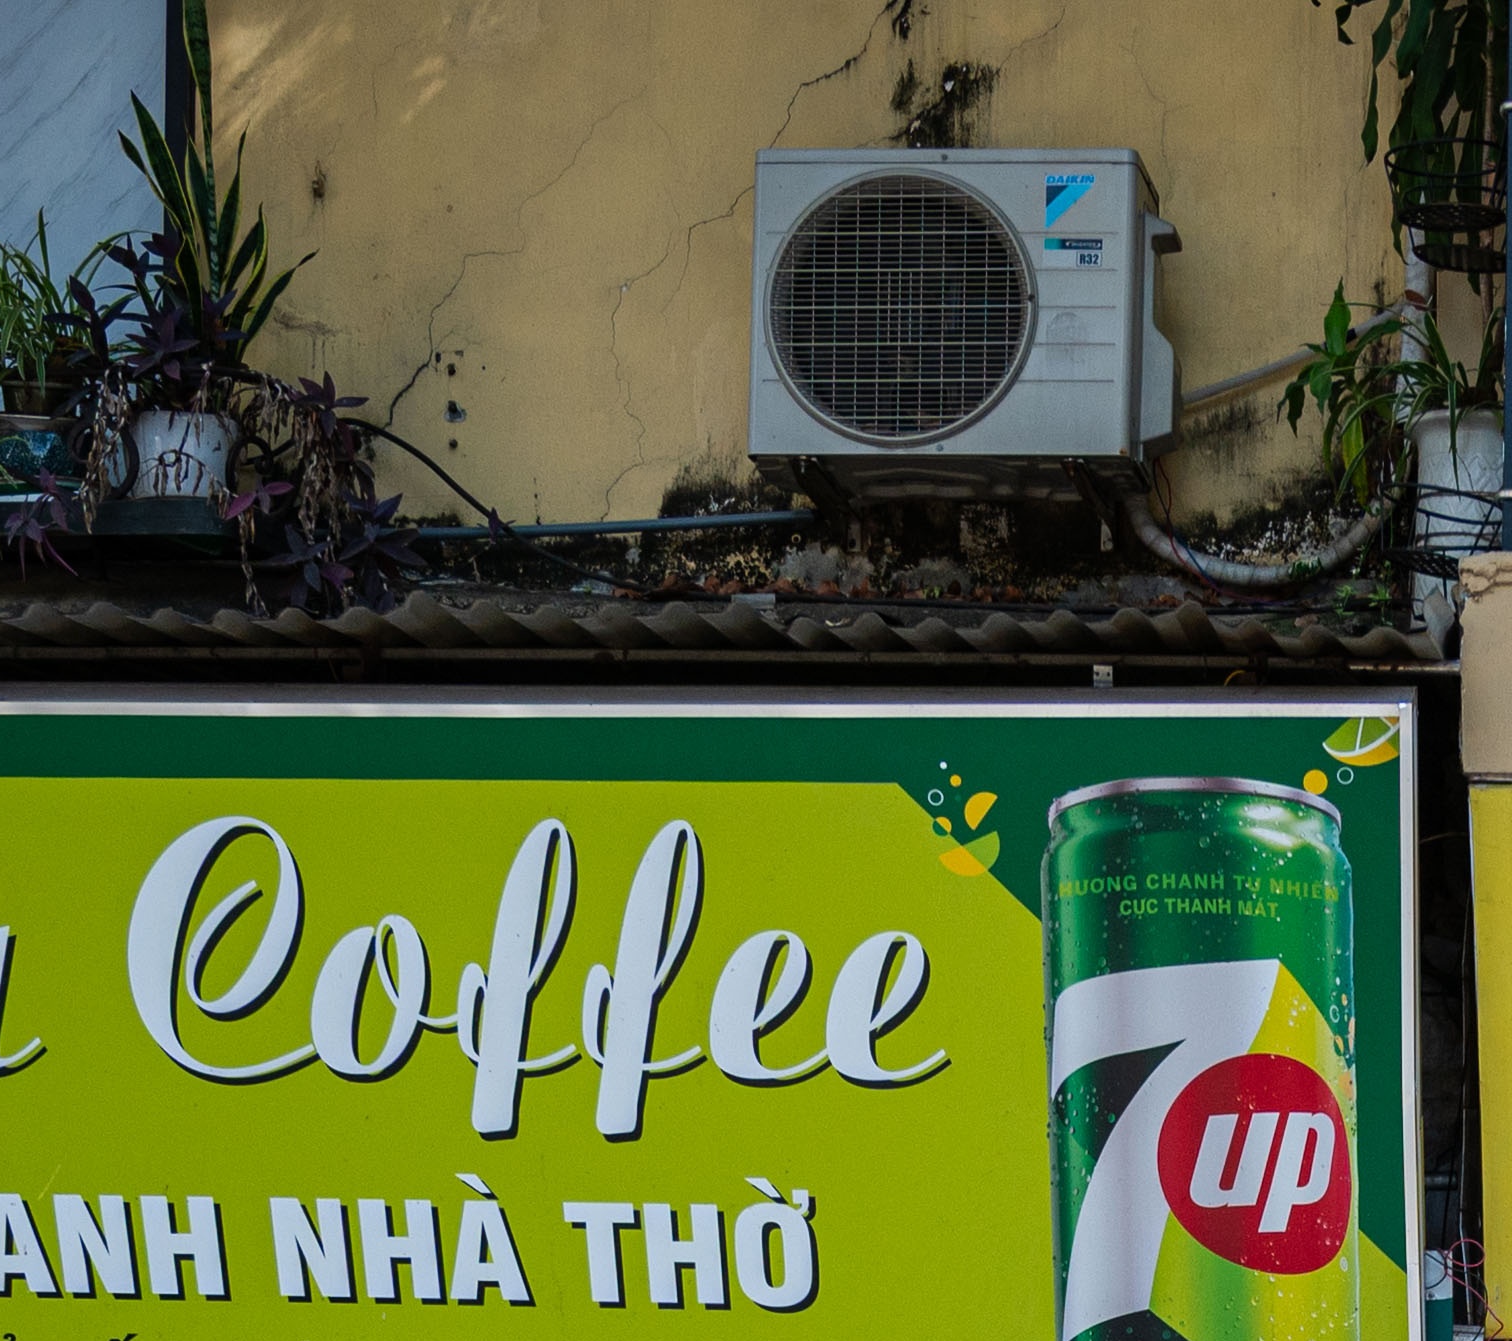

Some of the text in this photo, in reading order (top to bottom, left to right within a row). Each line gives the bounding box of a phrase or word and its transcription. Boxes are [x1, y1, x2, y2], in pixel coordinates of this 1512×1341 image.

[1046, 174, 1095, 184] DAIKIN
[1079, 253, 1100, 265] R32
[1146, 873, 1225, 891] CHANH
[1119, 898, 1279, 920] CỰC THANH MÁT
[127, 815, 951, 1142] Coffee
[269, 1172, 534, 1311] NHÀ
[564, 1176, 821, 1314] THỜ
